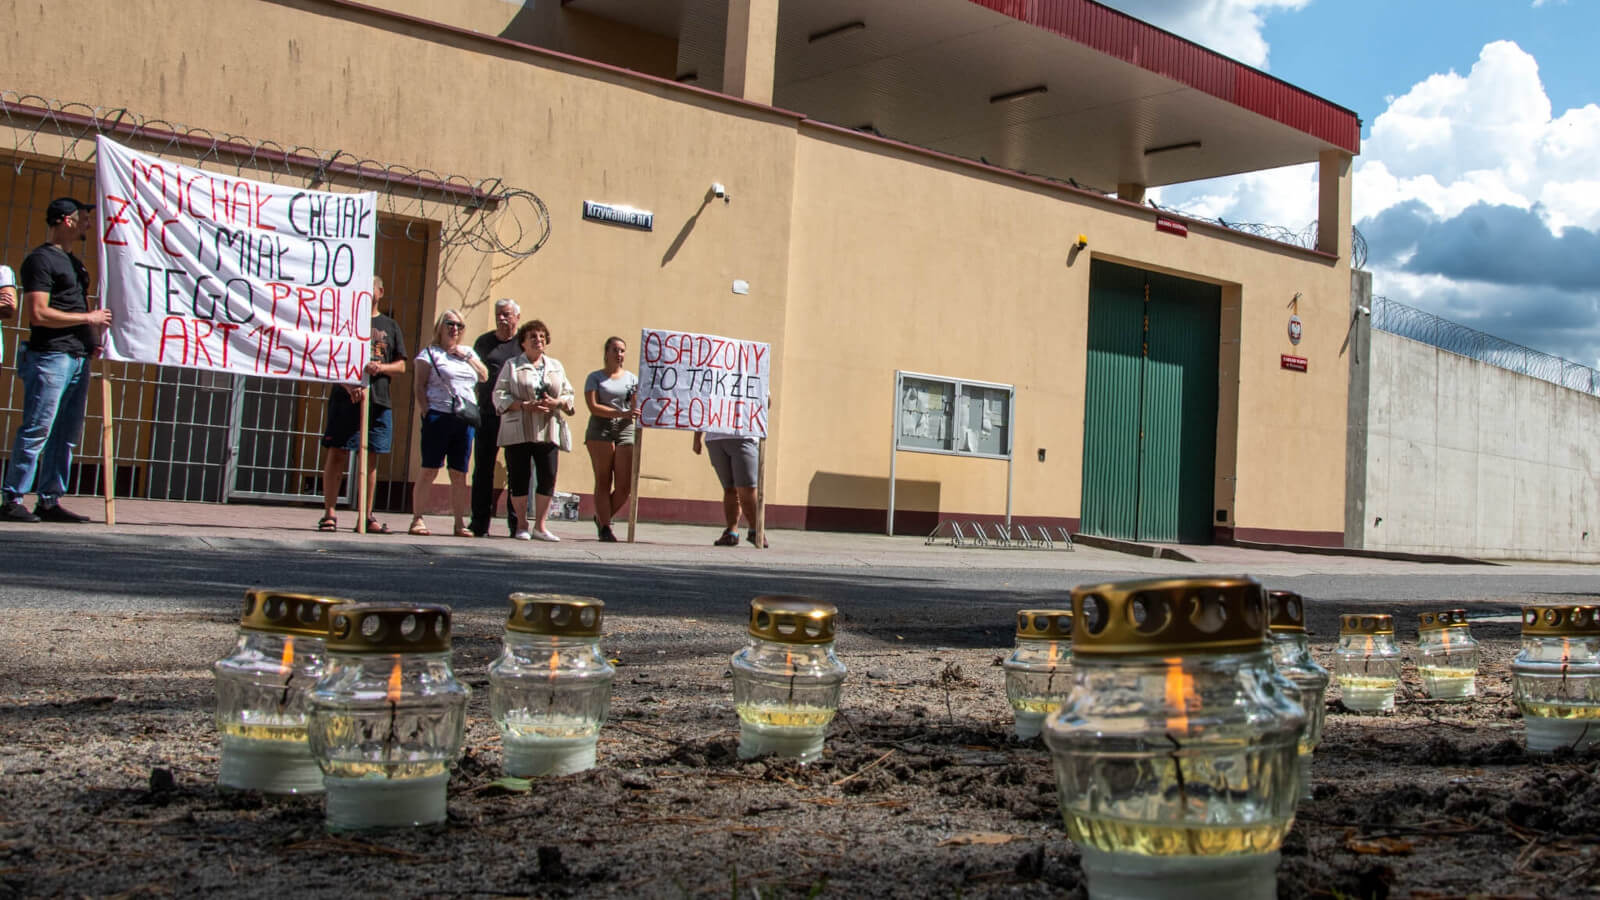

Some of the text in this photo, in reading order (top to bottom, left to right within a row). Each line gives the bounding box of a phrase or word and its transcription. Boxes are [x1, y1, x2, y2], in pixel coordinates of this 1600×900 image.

[288, 192, 371, 238] CHCIAŁ
[216, 227, 294, 280] MIAŁ
[306, 237, 355, 287] DO
[134, 262, 255, 324] TEGO
[644, 332, 766, 375] OSADZONY
[648, 365, 678, 391] TO
[640, 397, 765, 432] CZŁOWIEK
